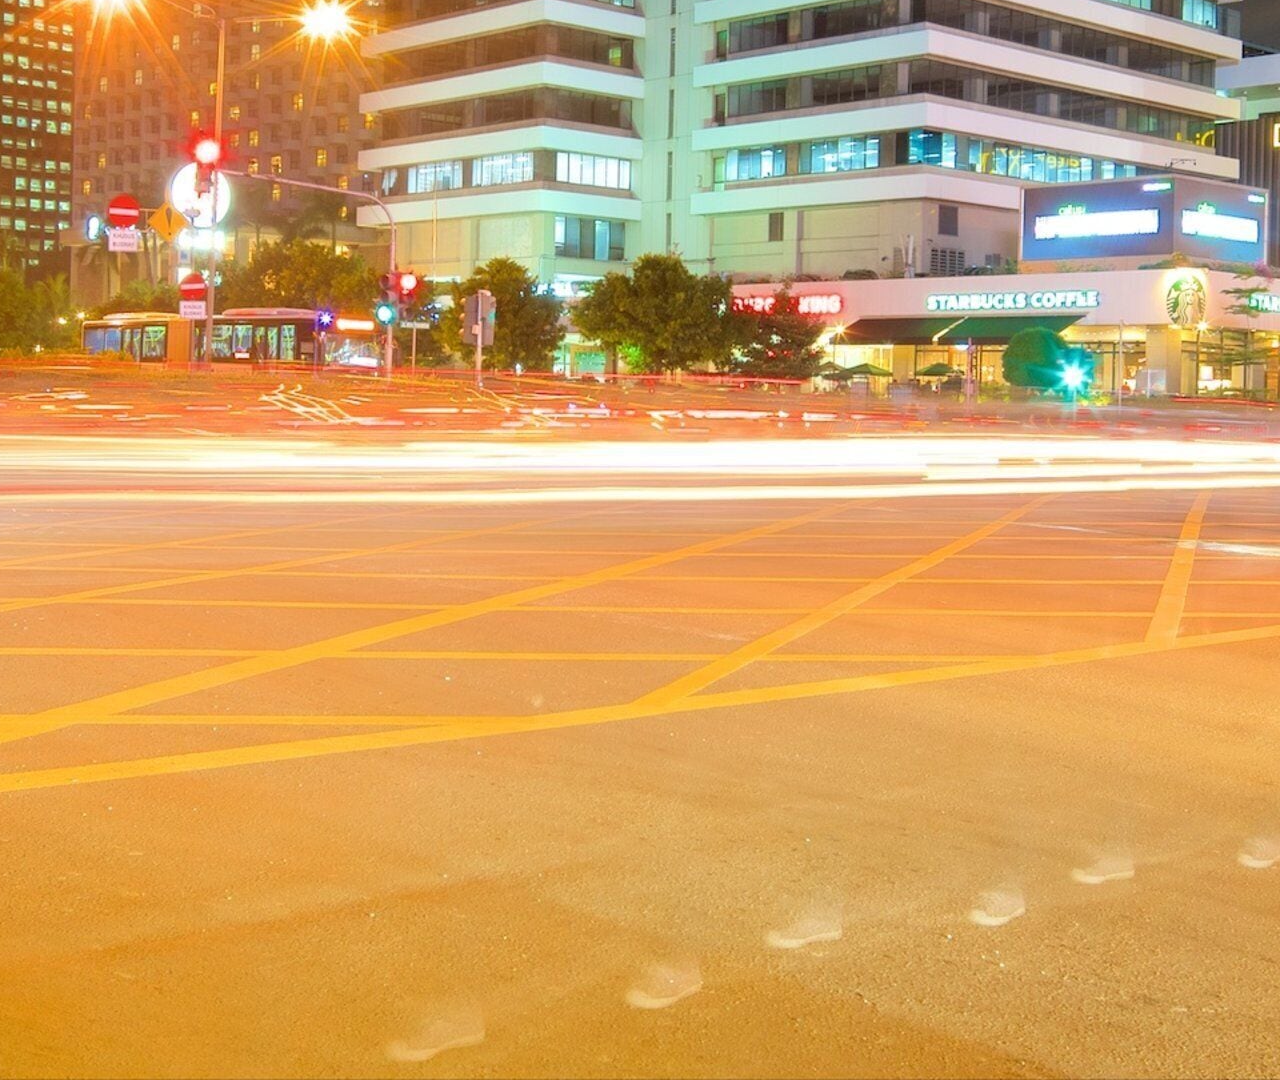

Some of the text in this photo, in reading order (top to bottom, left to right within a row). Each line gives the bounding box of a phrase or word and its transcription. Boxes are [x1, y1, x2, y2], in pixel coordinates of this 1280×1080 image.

[798, 294, 842, 314] KING
[927, 290, 1099, 311] STARBUCKS COFFEE
